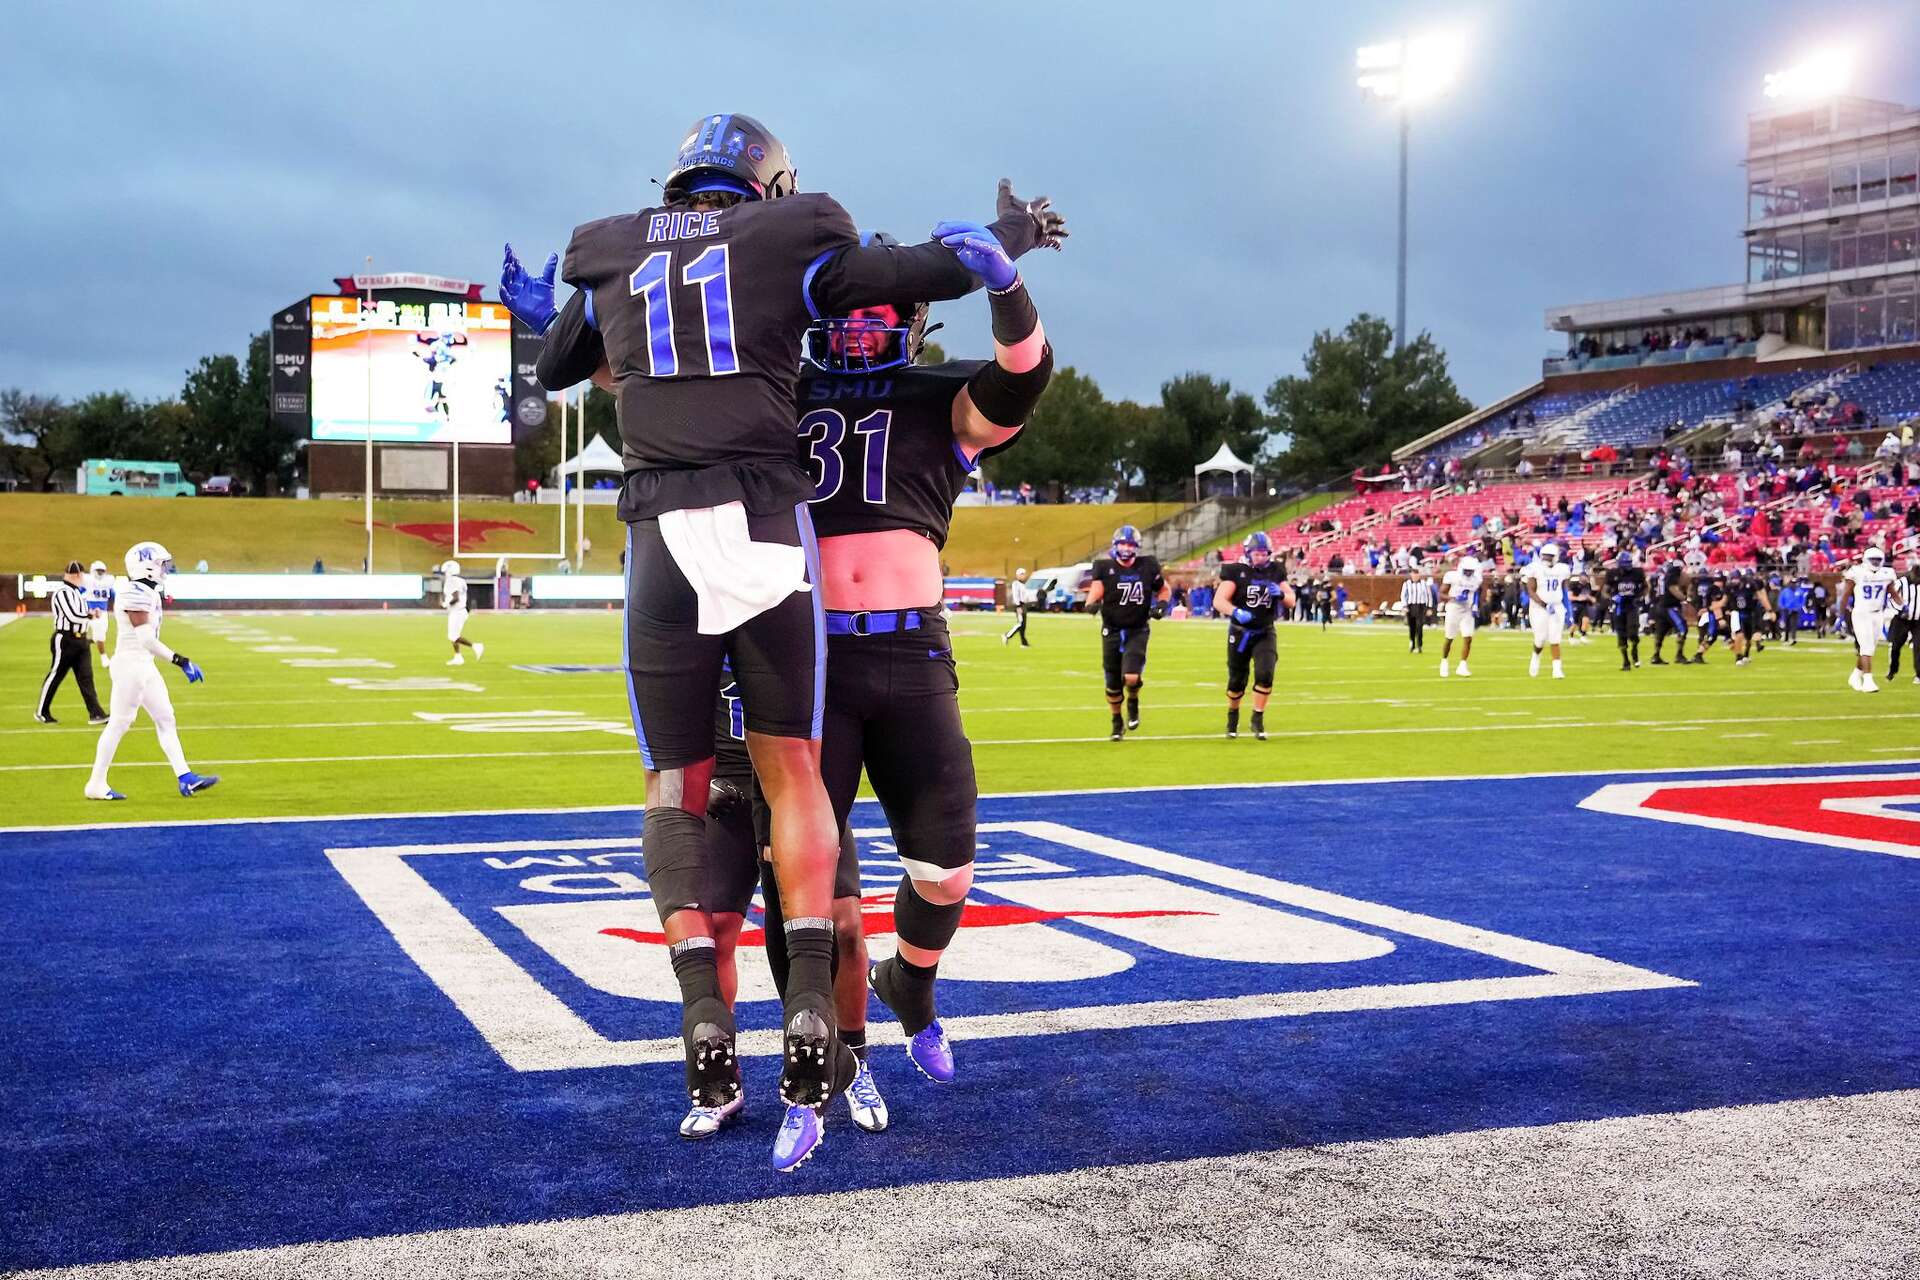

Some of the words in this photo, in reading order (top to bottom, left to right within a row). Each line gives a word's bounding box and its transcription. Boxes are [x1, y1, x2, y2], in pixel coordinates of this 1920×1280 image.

[646, 210, 723, 242] RICE
[629, 243, 740, 376] 11
[275, 354, 305, 365] SMU
[518, 364, 537, 374] SM
[808, 379, 894, 400] SMU
[797, 407, 893, 504] 31
[1116, 581, 1145, 606] 74
[1246, 585, 1272, 608] 54
[1546, 579, 1559, 592] 10
[1862, 585, 1883, 600] 97
